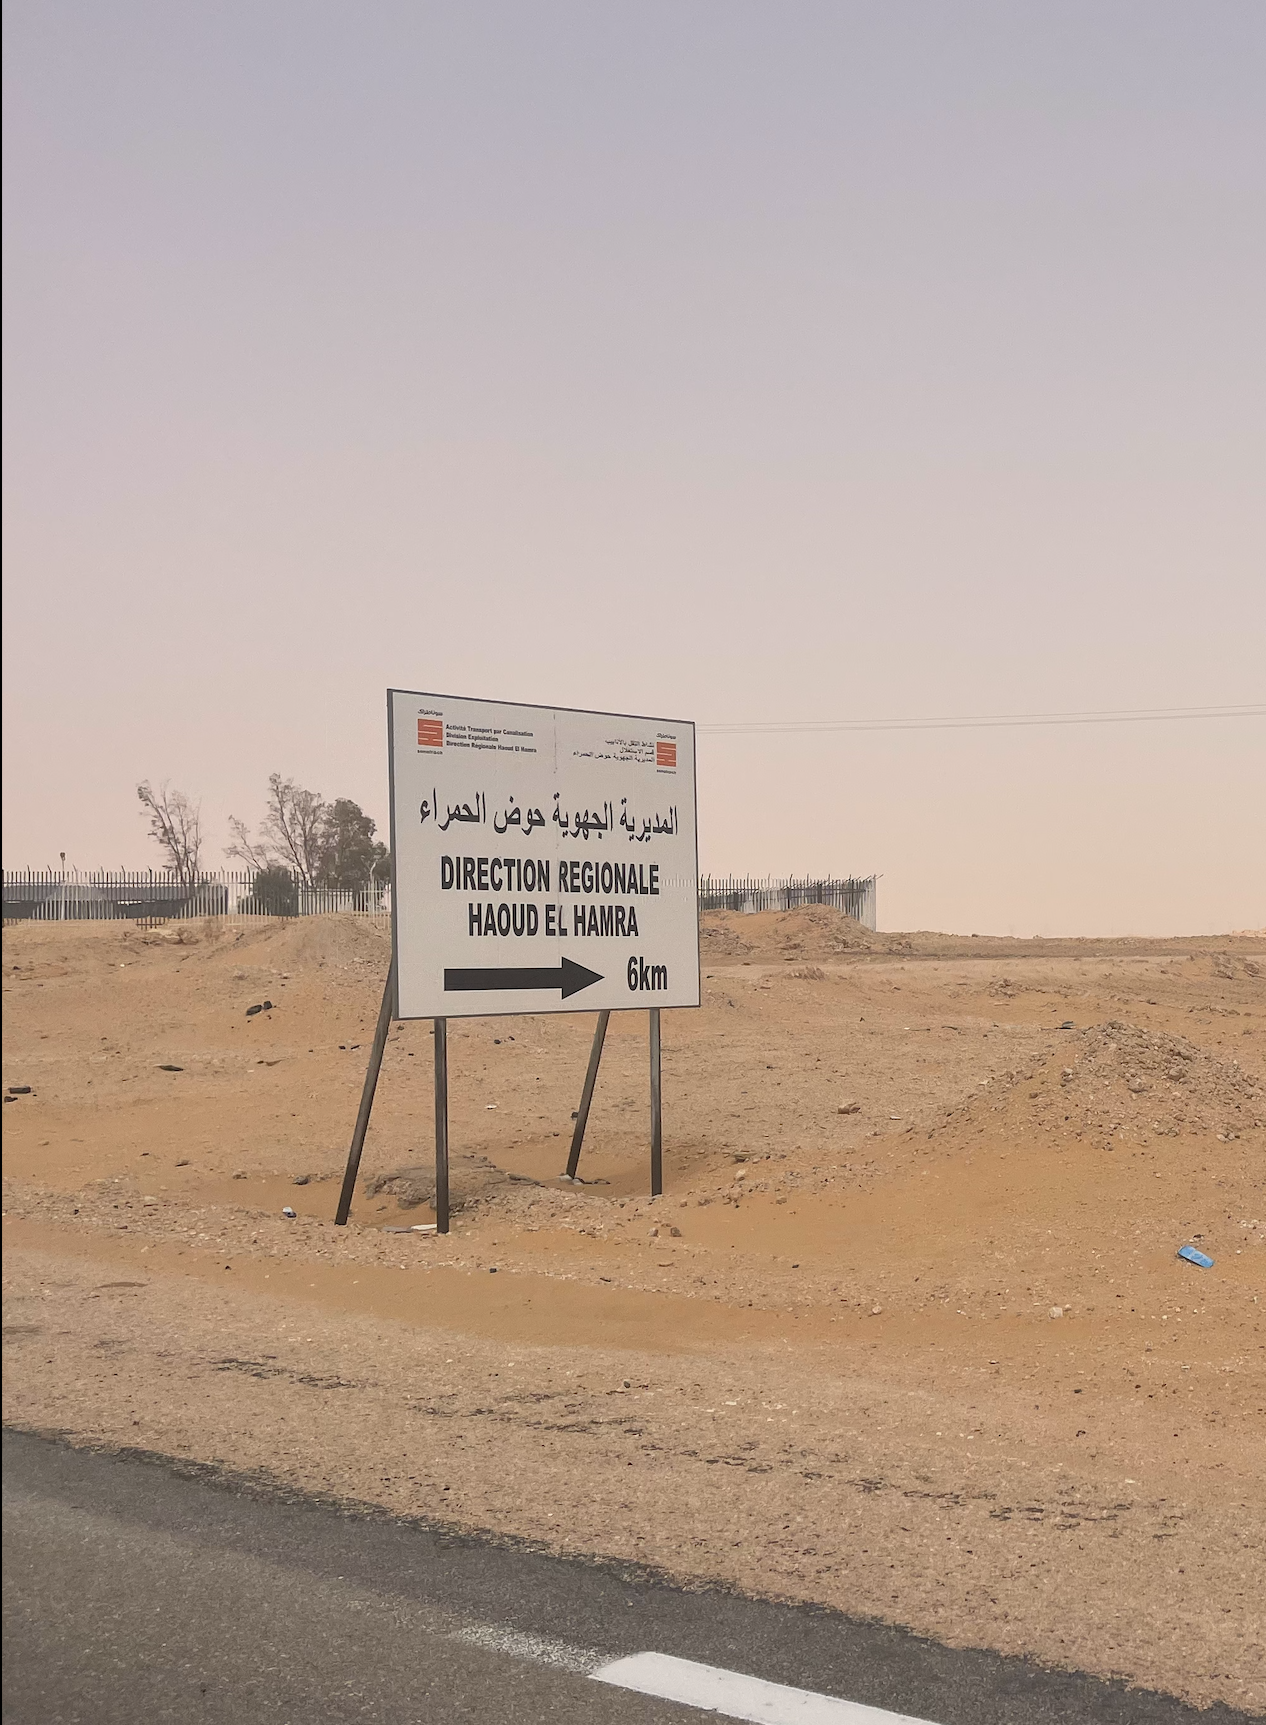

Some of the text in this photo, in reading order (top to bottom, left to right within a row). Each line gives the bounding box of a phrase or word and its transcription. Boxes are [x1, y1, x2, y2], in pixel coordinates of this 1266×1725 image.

[419, 787, 678, 842] المديرية الجهوية حوض الحمراء
[441, 855, 660, 895] DIRECTION REGIONALE
[468, 902, 639, 937] HAOUD EL HAMRA
[627, 956, 668, 991] 6km
